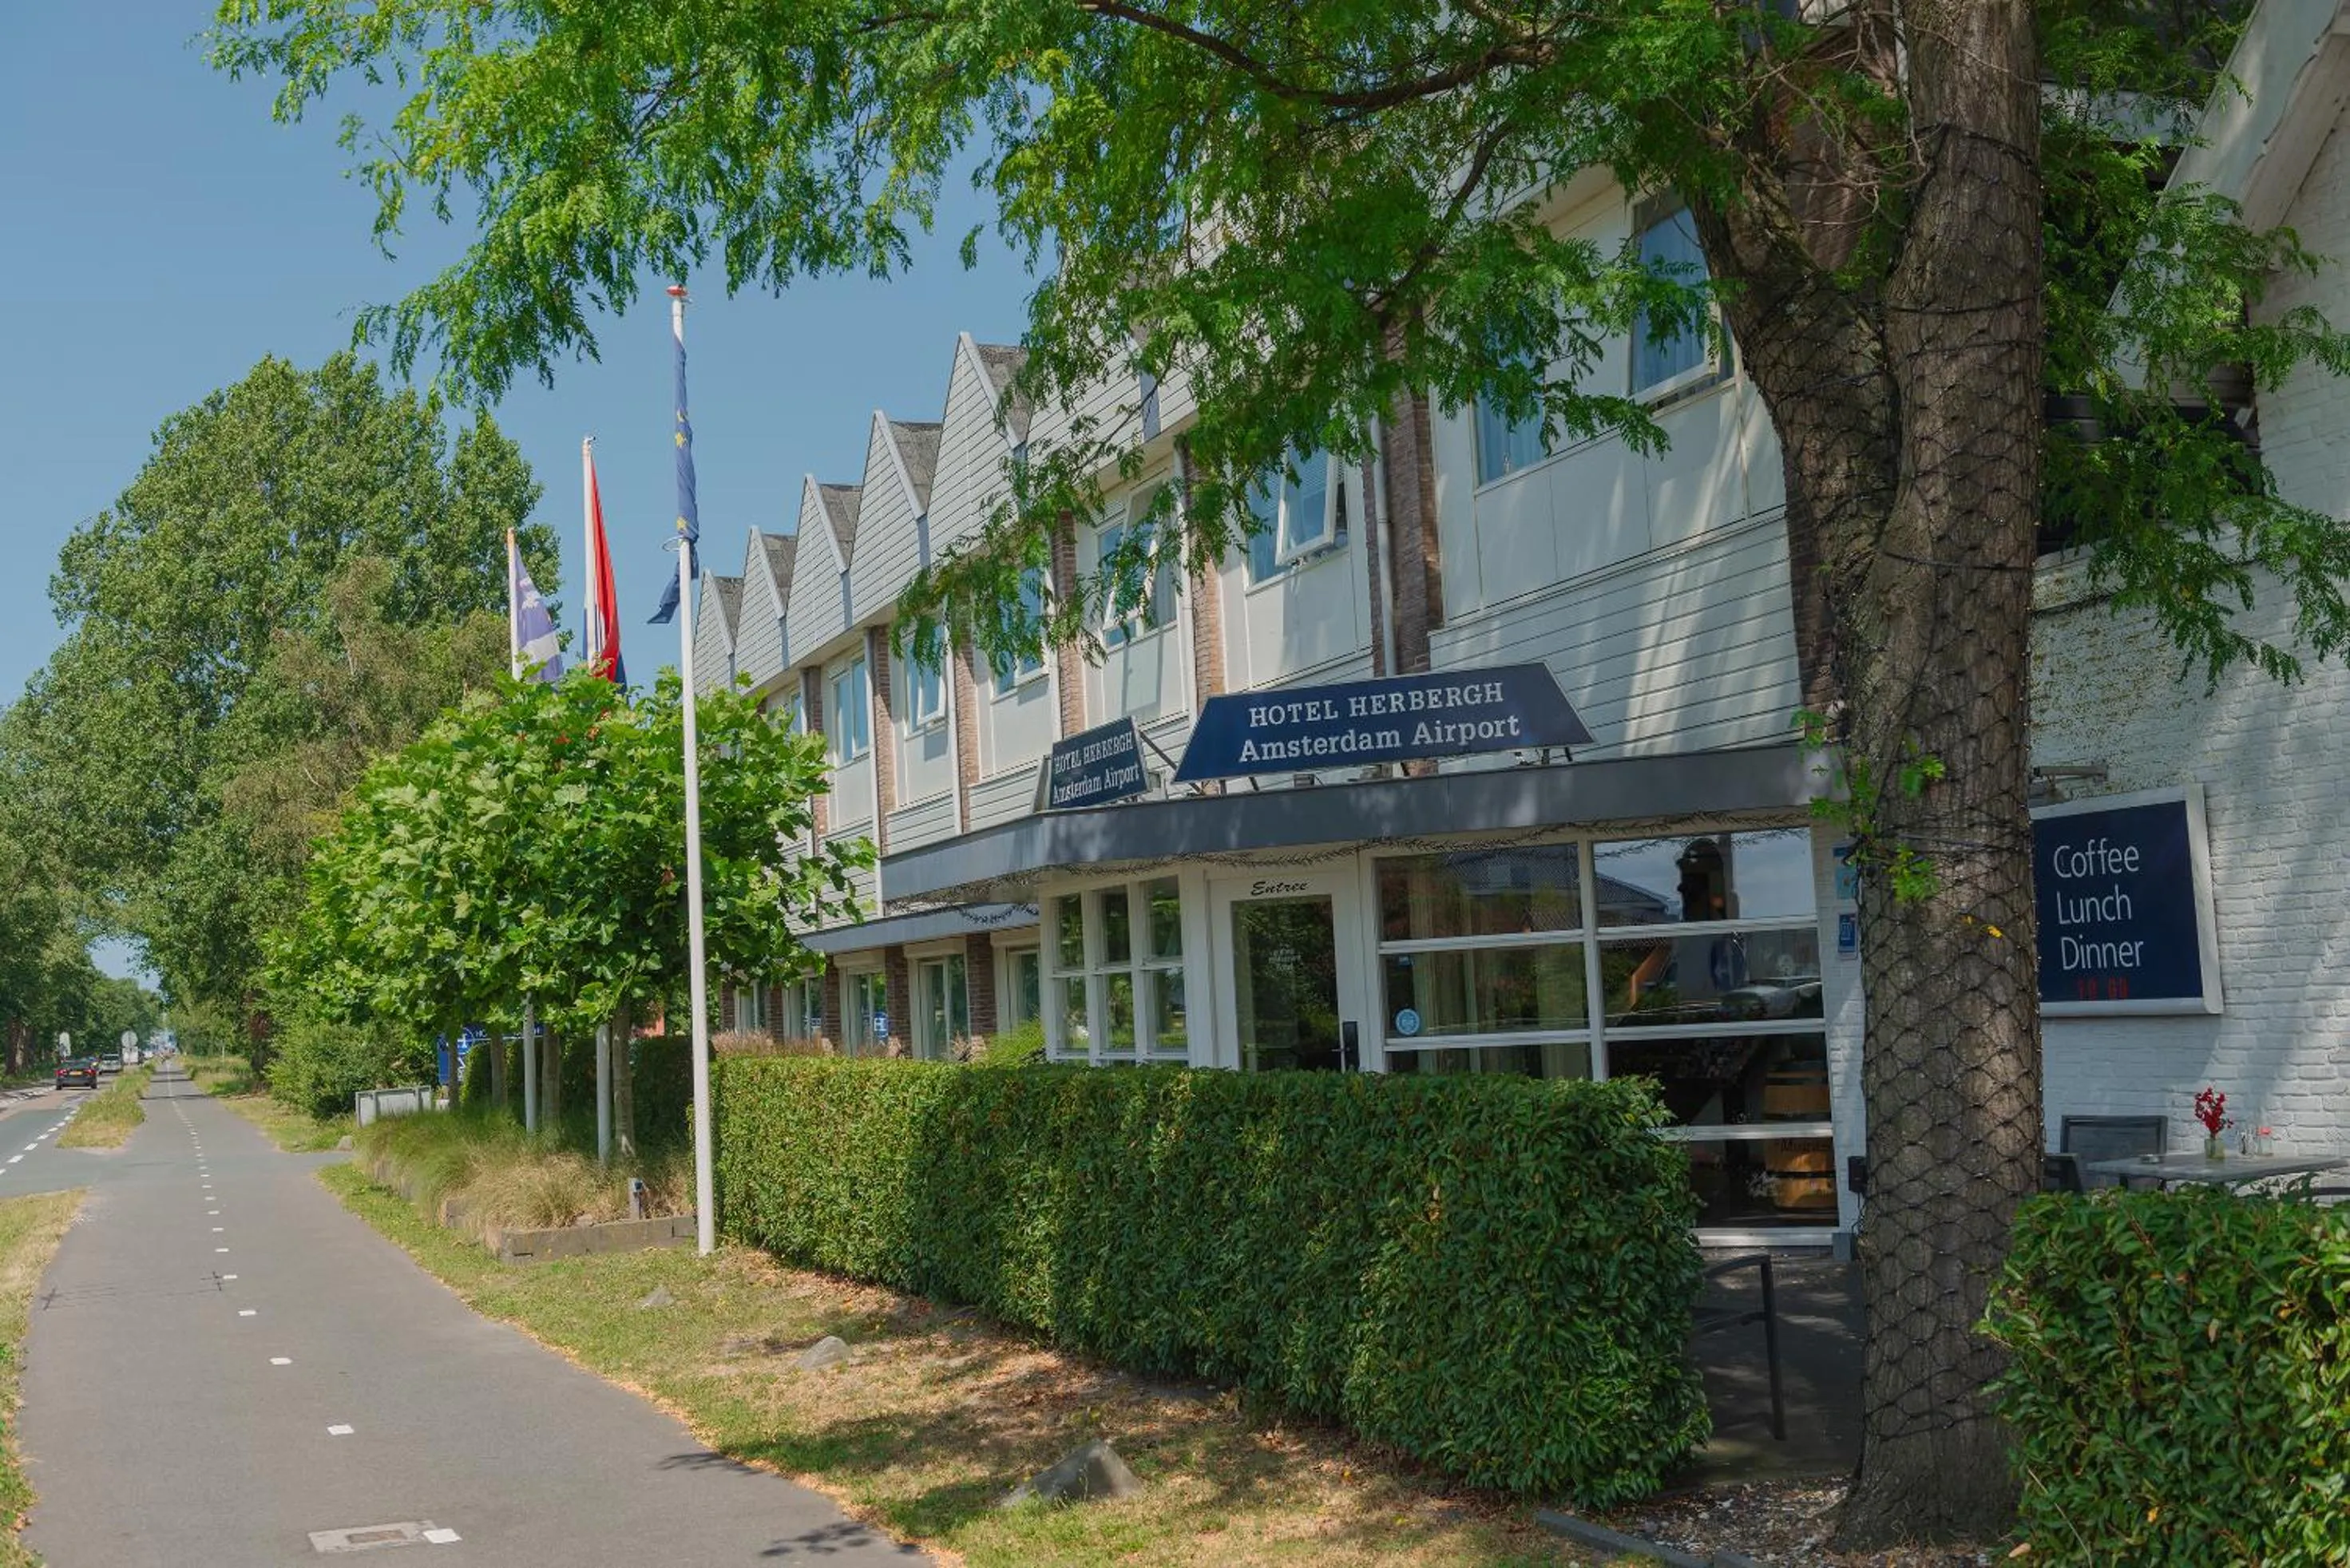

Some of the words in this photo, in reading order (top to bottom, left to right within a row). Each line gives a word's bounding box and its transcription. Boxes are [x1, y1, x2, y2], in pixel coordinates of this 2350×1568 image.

[1248, 699, 1339, 727] HOTEL
[1348, 682, 1504, 718] HERBERGH
[1054, 749, 1082, 774] HOTEL
[1084, 732, 1133, 765] HERBERGH
[1238, 729, 1402, 762] Amsterdam
[1411, 714, 1520, 746] Airport
[1052, 774, 1103, 805] Amsterdam
[1104, 763, 1139, 790] Airport
[2053, 837, 2140, 878] Coffee
[2056, 883, 2132, 925] Lunch
[2060, 934, 2144, 971] Dinner
